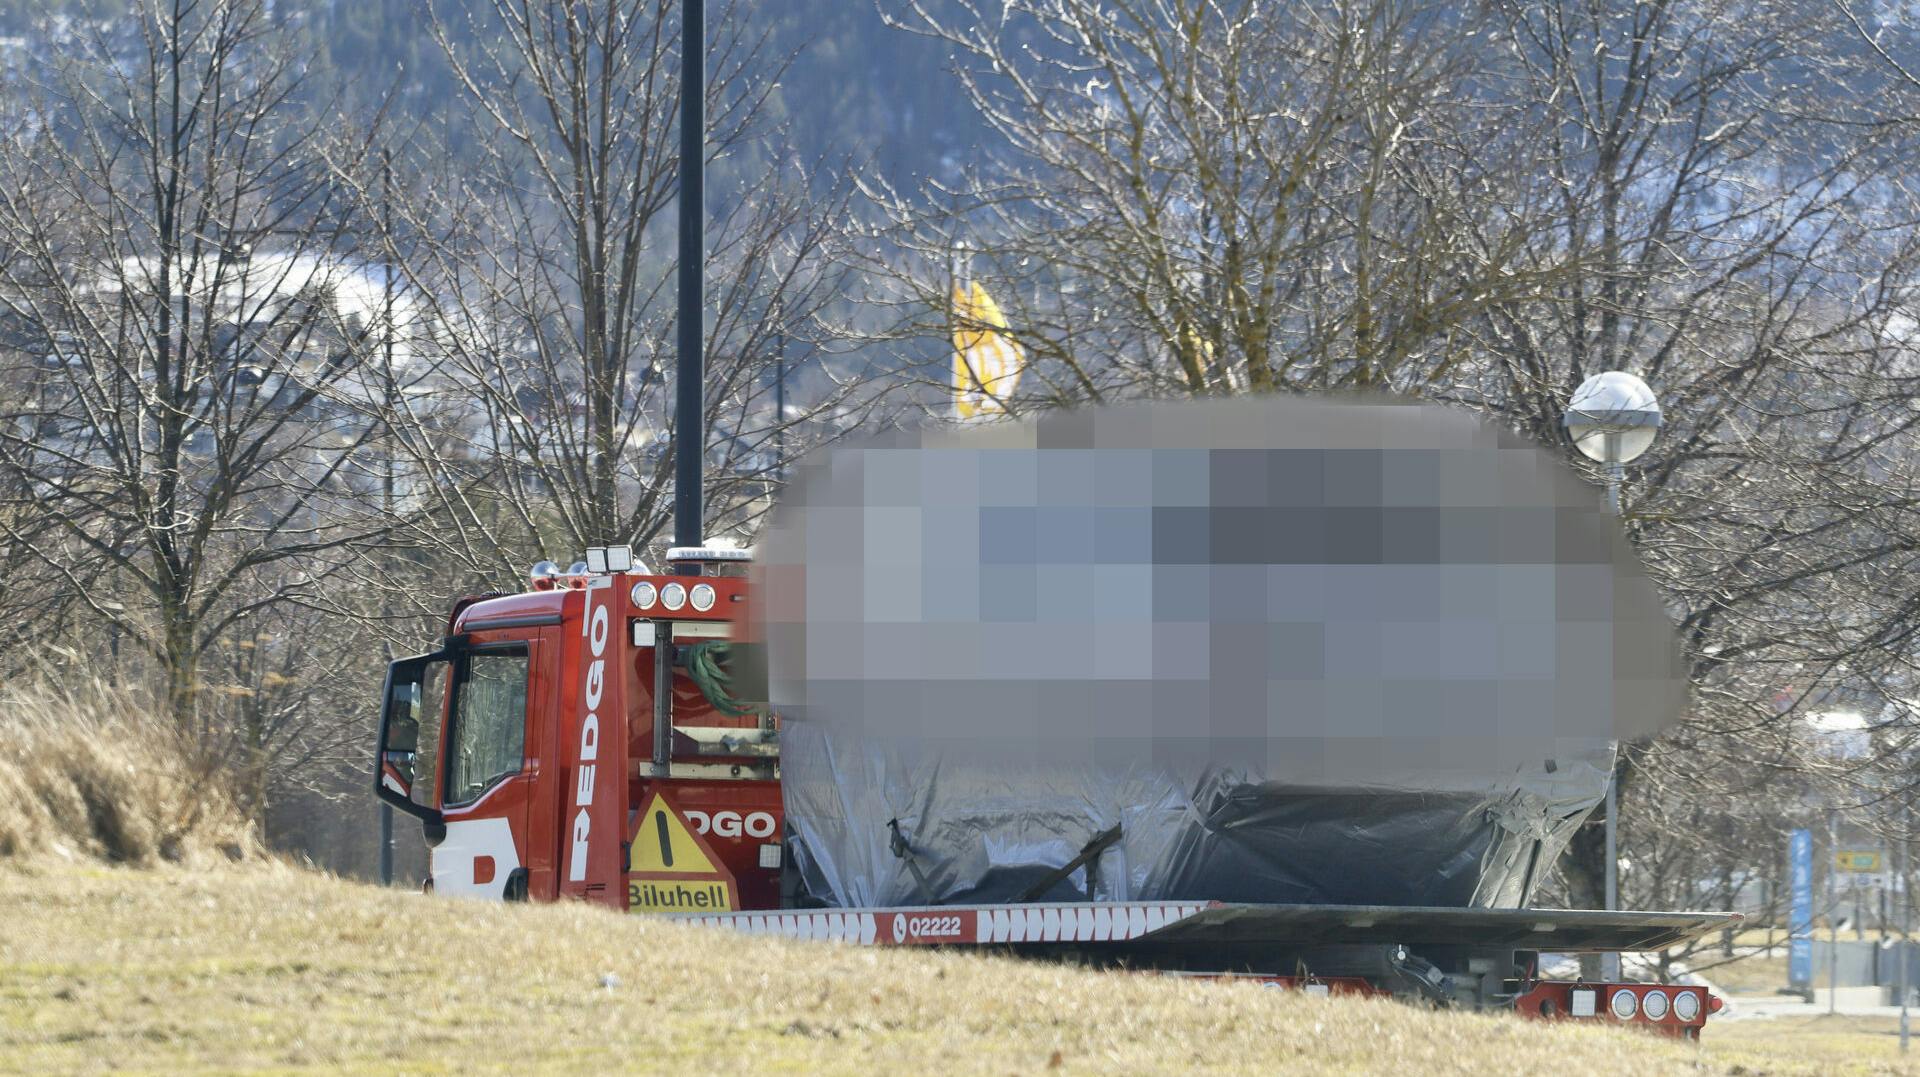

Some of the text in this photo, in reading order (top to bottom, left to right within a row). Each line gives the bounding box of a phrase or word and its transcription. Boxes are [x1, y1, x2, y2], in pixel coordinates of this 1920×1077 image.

[569, 604, 609, 881] REDGO
[629, 884, 725, 908] Biluhell
[909, 916, 961, 937] 02222
